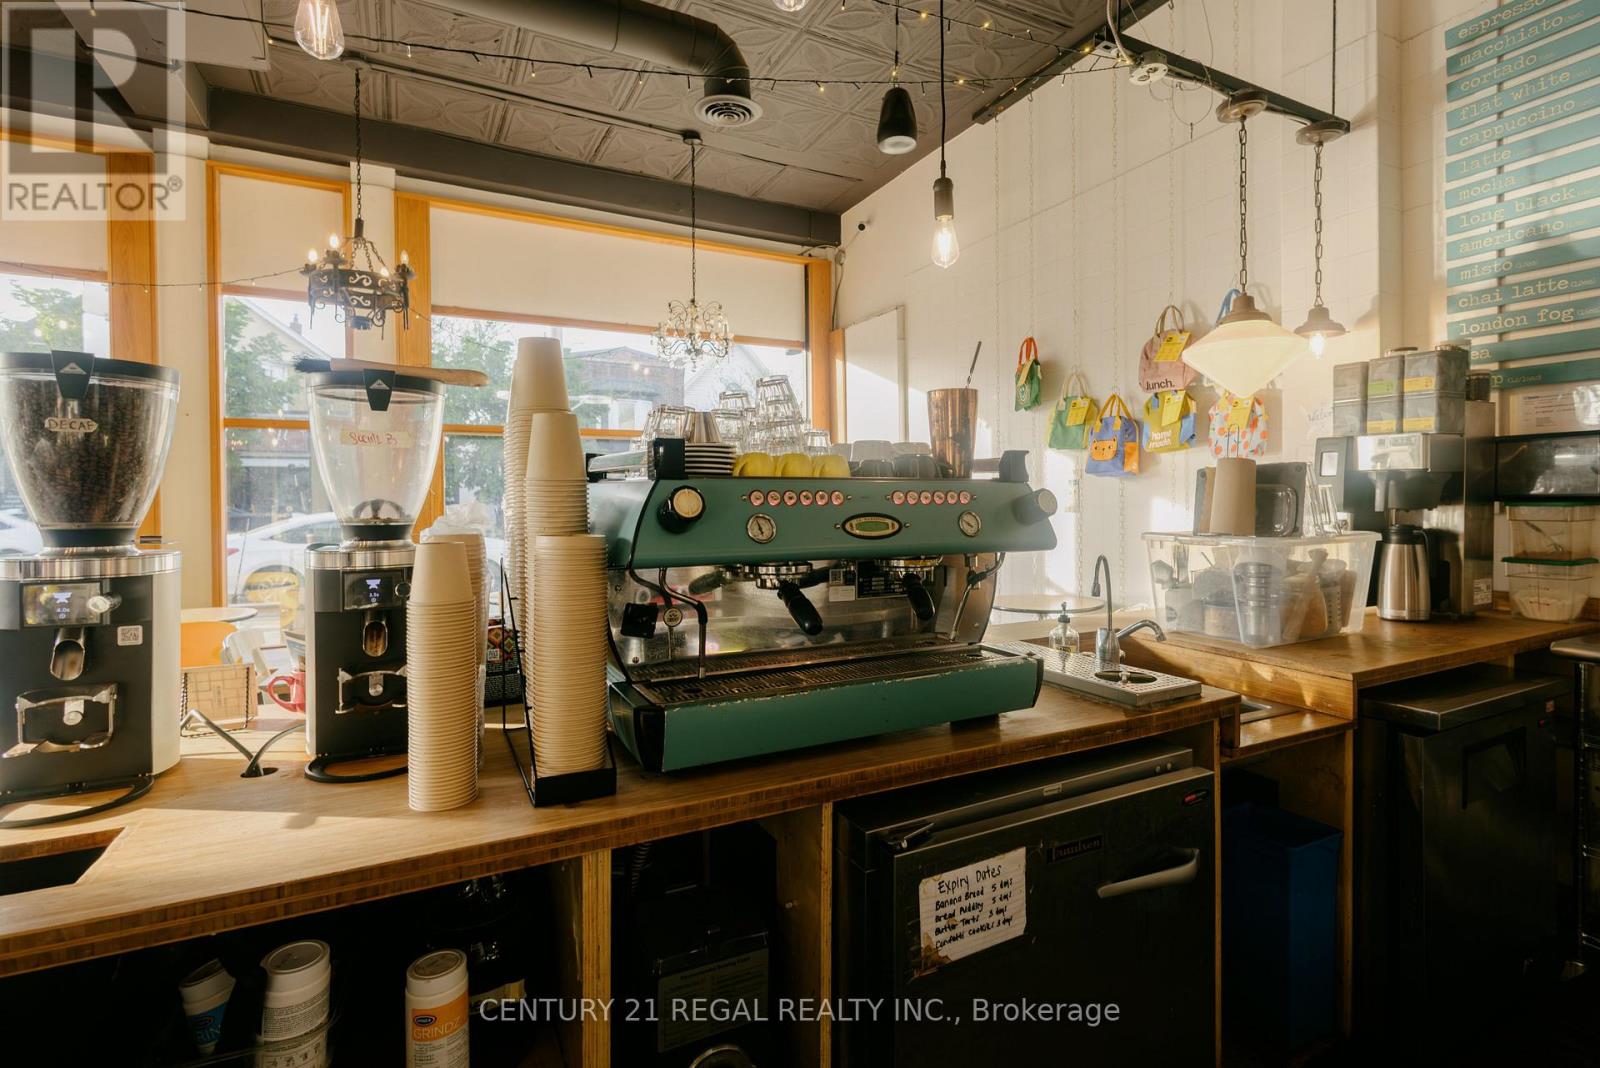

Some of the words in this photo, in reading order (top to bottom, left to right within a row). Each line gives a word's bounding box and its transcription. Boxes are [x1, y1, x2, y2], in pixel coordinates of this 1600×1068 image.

[1459, 16, 1563, 66] macchiato
[1460, 54, 1537, 91] cortado
[1459, 96, 1503, 121] flat
[1511, 71, 1570, 101] white
[1459, 100, 1575, 146] cappuccino
[1461, 150, 1511, 174] latte
[1459, 175, 1516, 200] mocha
[1459, 207, 1505, 227] long
[1515, 187, 1575, 212] black
[1459, 220, 1564, 253] americano
[1460, 261, 1513, 280] misto
[1458, 289, 1502, 308] chai
[1512, 278, 1569, 299] latte
[1459, 315, 1528, 336] london
[1537, 308, 1574, 322] fog
[1471, 349, 1491, 360] ea
[47, 419, 95, 431] DECAF
[937, 875, 969, 895] Expiry
[976, 865, 1001, 883] Dates
[935, 896, 962, 911] Banana
[965, 886, 984, 900] Bread
